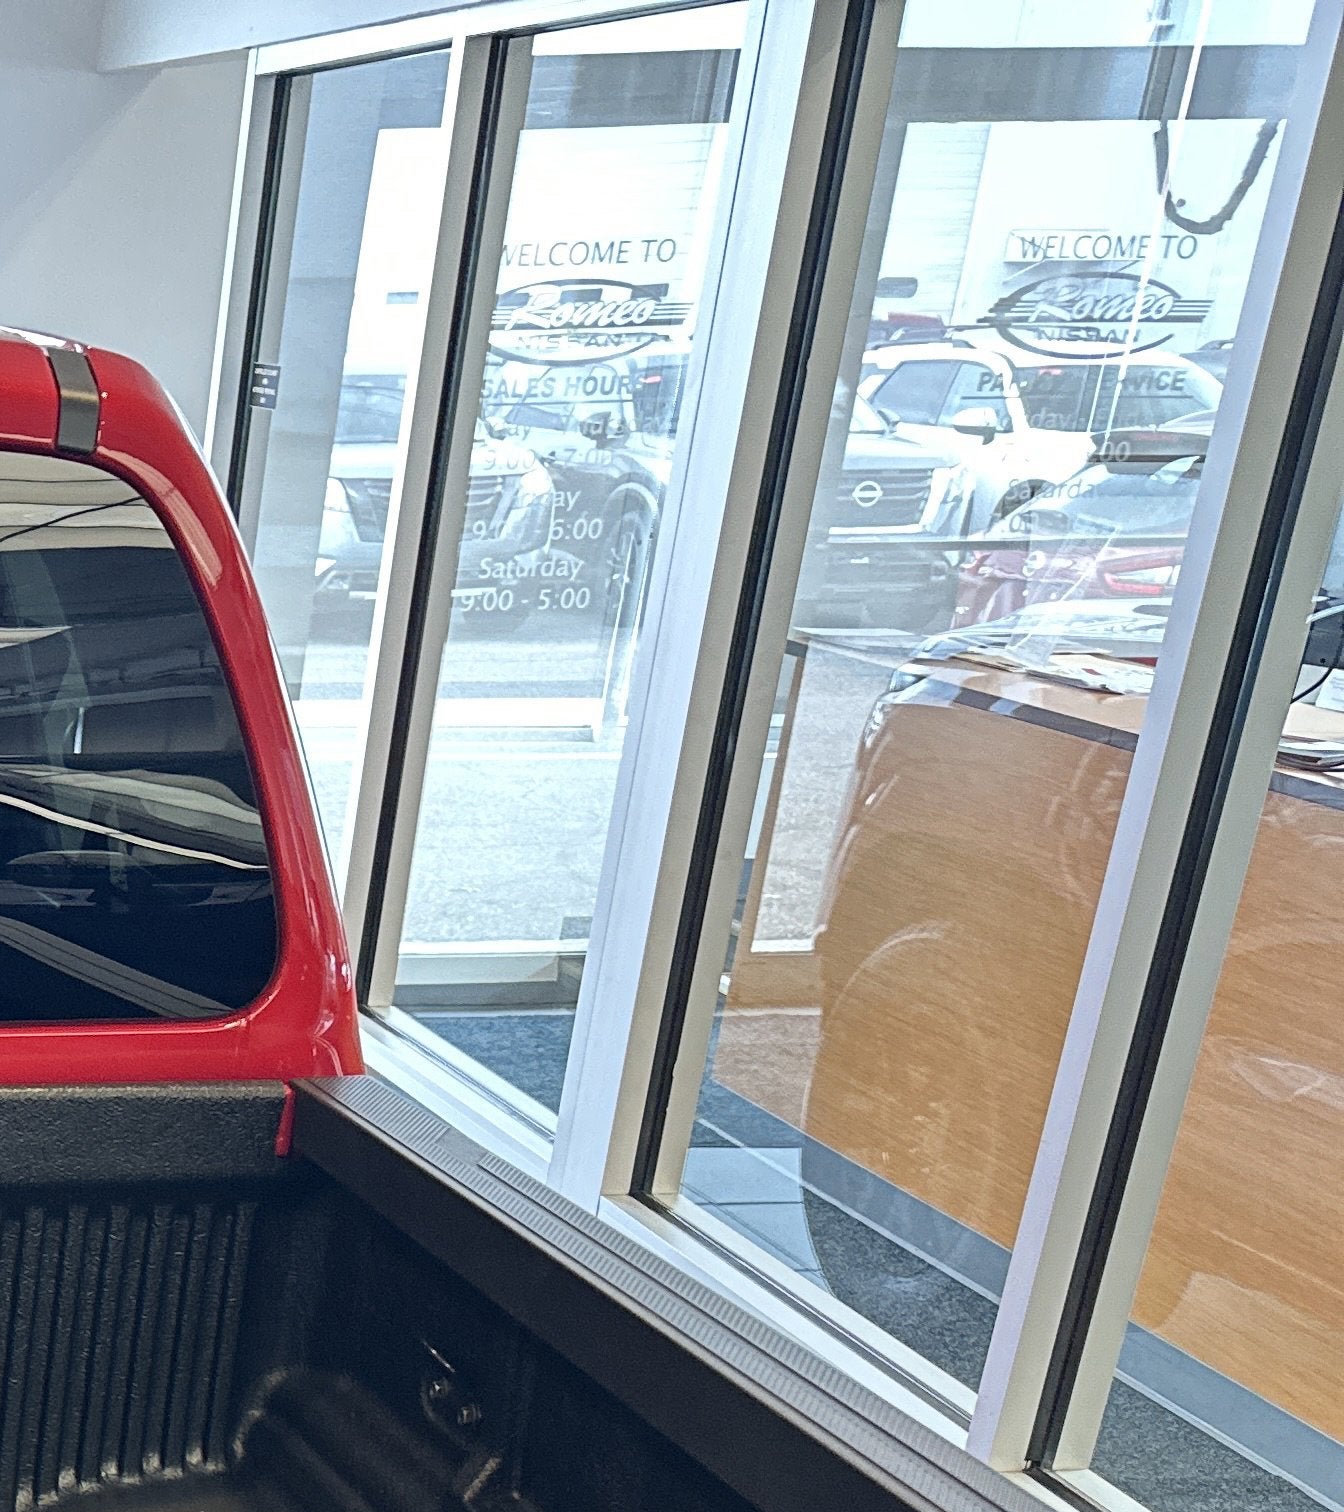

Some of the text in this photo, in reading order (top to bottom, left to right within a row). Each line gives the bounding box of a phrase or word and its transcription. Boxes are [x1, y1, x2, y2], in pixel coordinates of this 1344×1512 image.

[641, 238, 677, 263] TO
[1019, 234, 1198, 260] WELCOME TO
[505, 284, 657, 331] Romeo
[1027, 277, 1174, 322] Romeo
[481, 378, 554, 399] SALES
[479, 557, 584, 582] Saturday
[460, 589, 513, 612] 9:00
[536, 587, 591, 611] 5:00
